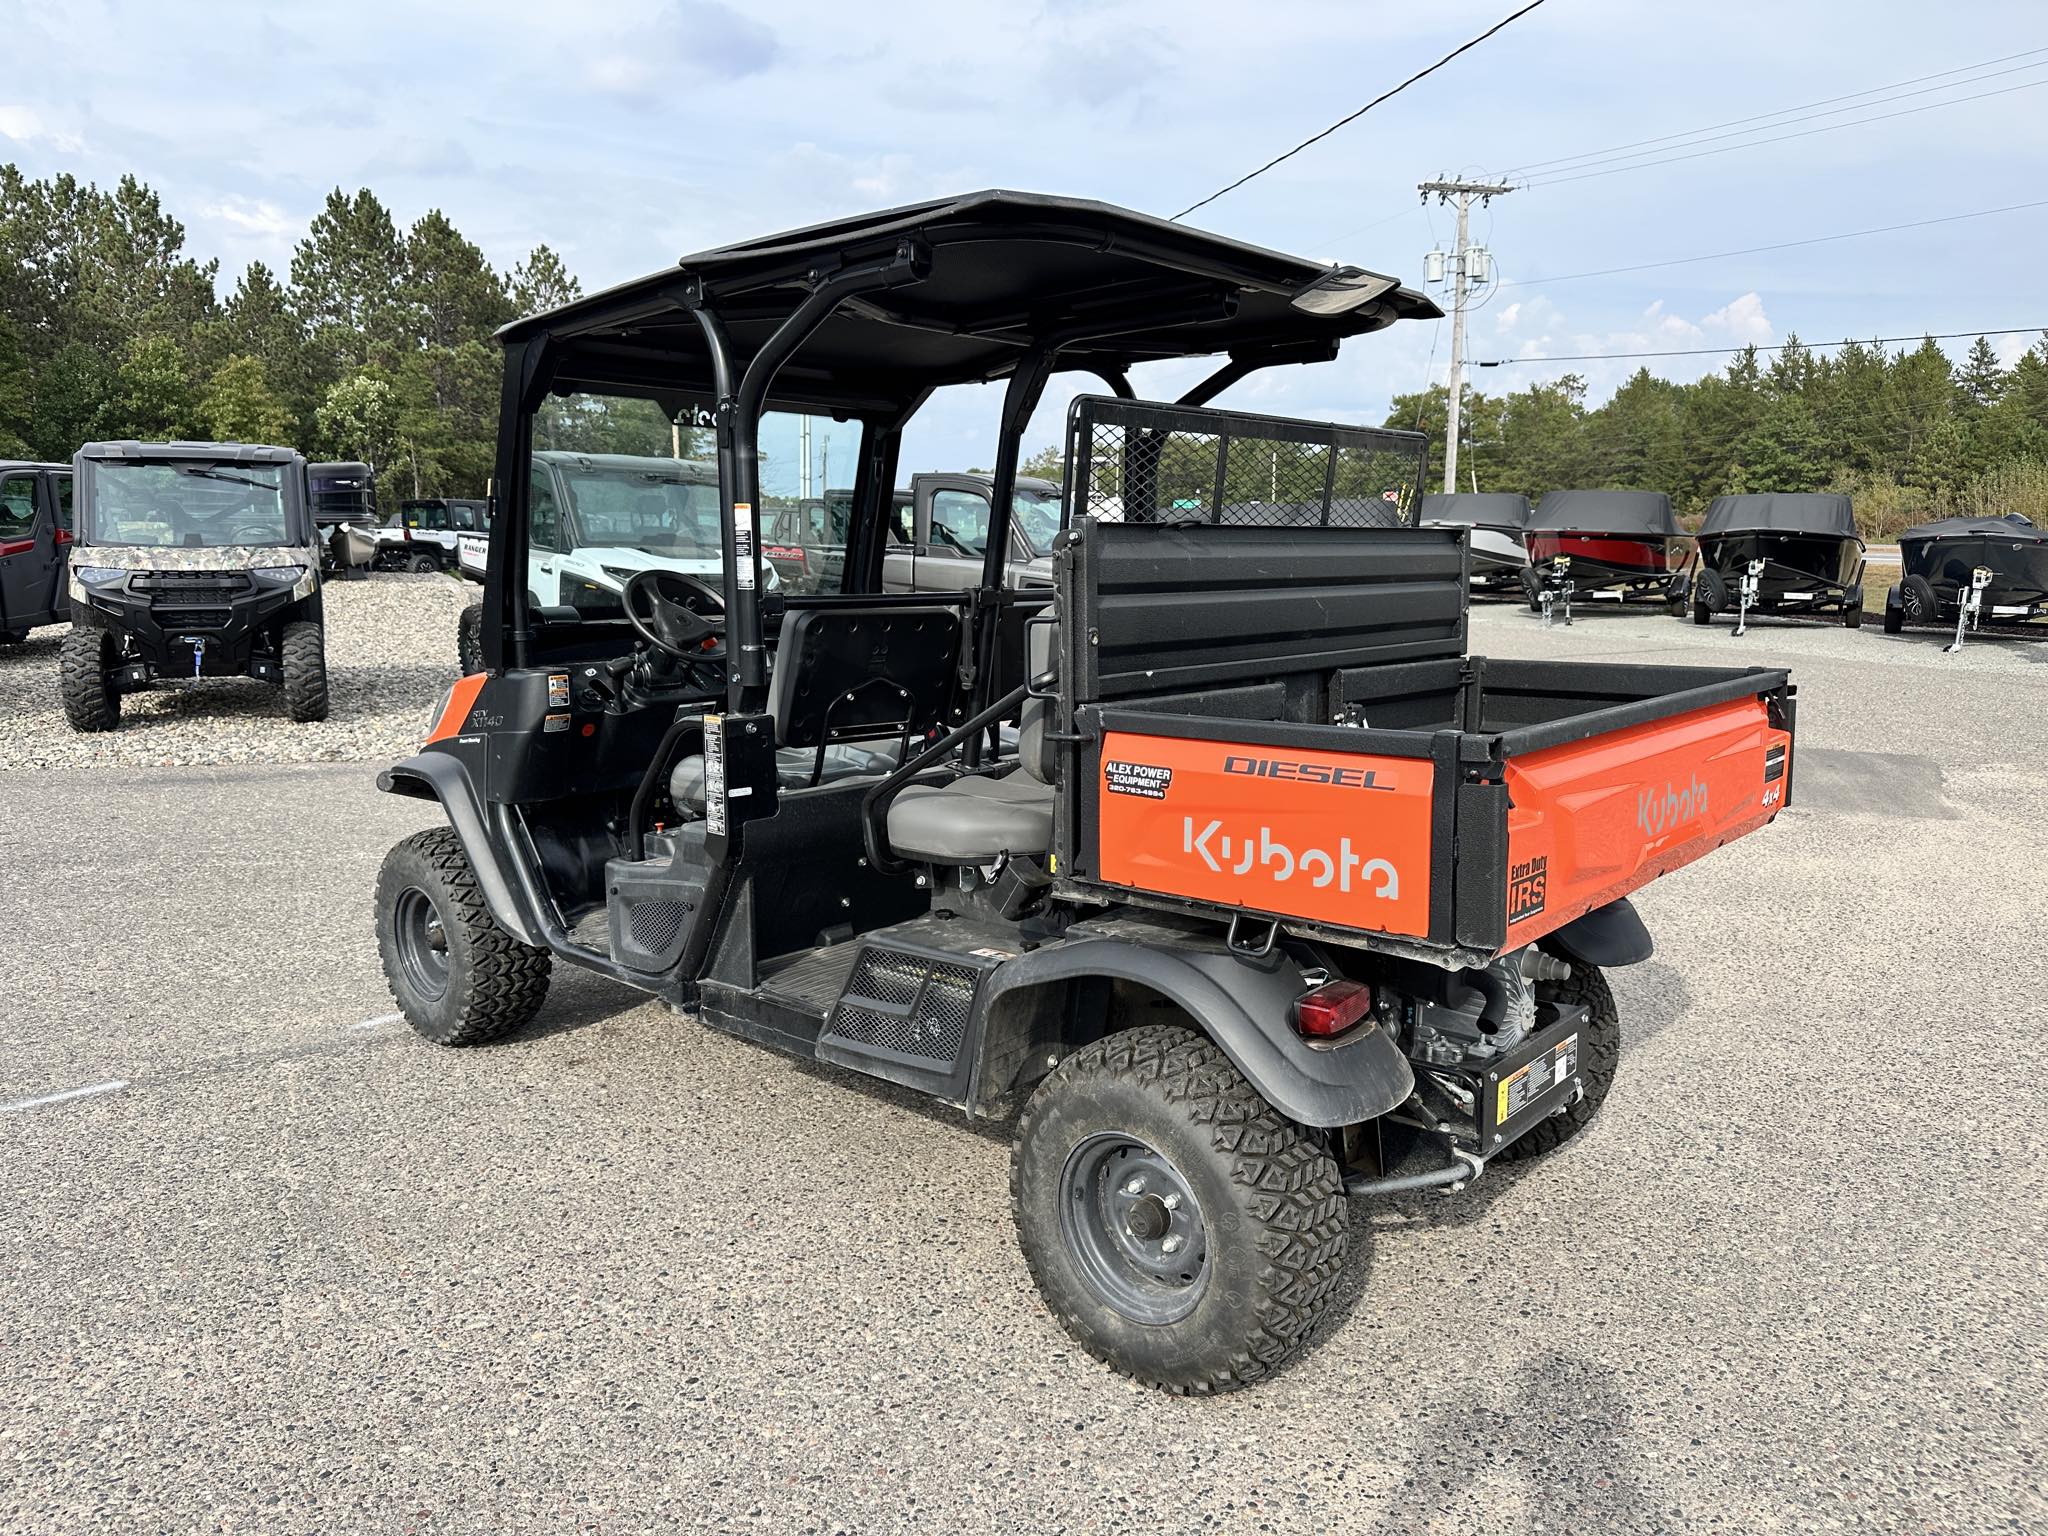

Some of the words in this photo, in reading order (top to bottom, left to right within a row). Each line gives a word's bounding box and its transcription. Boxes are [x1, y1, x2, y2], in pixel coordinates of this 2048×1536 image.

[464, 544, 487, 554] RANGER
[1105, 763, 1132, 775] ALEX
[1133, 766, 1171, 781] POWER
[1112, 774, 1162, 789] EQUIPMENT
[1223, 756, 1396, 791] DIESEL
[1637, 772, 1709, 837] Kubota
[1762, 784, 1780, 807] 4x4
[1183, 816, 1399, 901] Kubota
[1511, 862, 1531, 881] Extra
[1531, 856, 1547, 873] Duty
[1511, 876, 1546, 914] IRS
